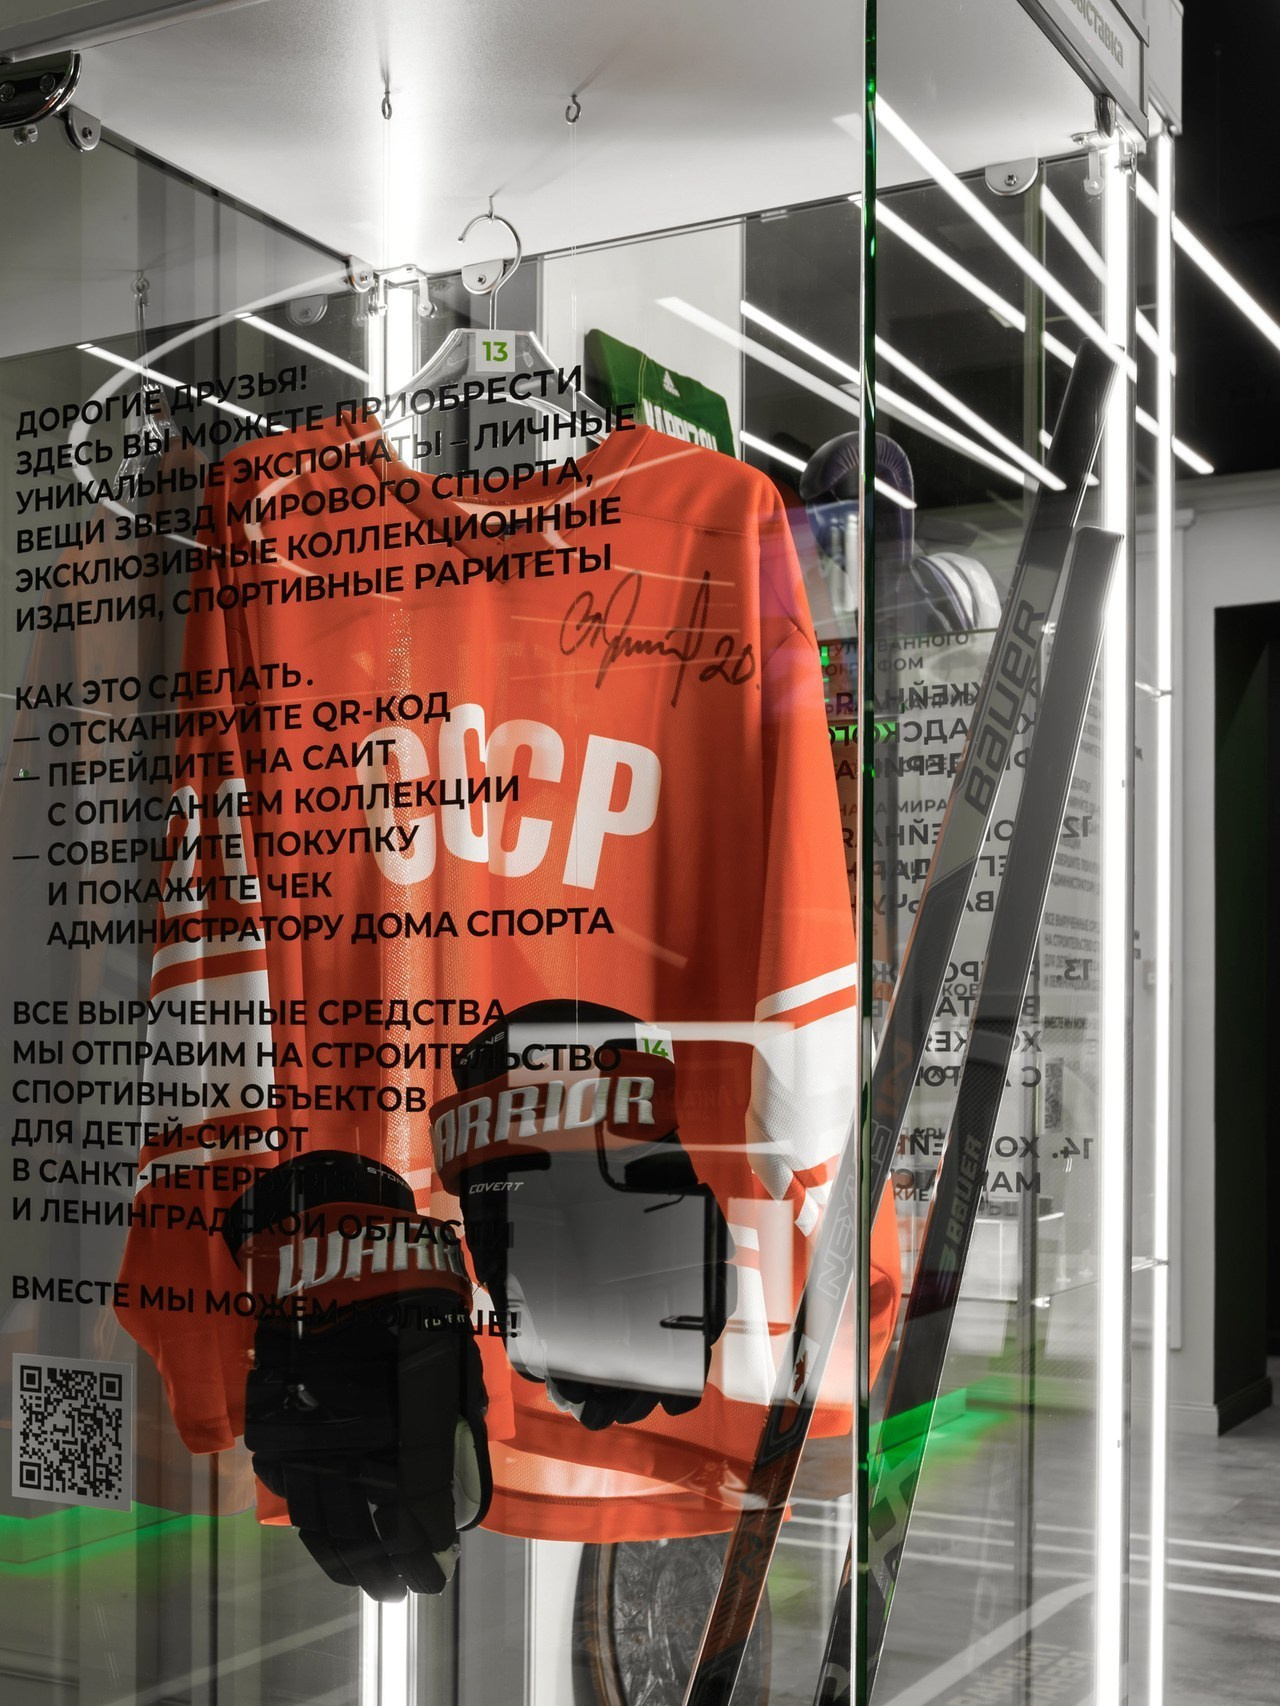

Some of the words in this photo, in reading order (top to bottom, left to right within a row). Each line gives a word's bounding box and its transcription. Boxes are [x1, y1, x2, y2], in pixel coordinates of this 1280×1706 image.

[482, 341, 508, 361] 13
[16, 388, 161, 438] ДОРОГИЕ
[171, 364, 308, 412] ДРУЗЬЯ!
[16, 440, 113, 477] ЗДЕСЬ
[124, 432, 171, 463] ВЫ
[181, 405, 323, 453] МОЖЕТЕ
[335, 364, 583, 428] ПРИОБРЕСТИ
[16, 463, 225, 515] УНИКАЛЬНЫЕ
[232, 428, 442, 485] ЭКСПОНАТЫ
[474, 402, 637, 453] ЛИЧНЫЕ
[17, 518, 106, 555] ВЕЩИ
[114, 503, 217, 543] ЗВЕЗД
[226, 475, 421, 528] МИРОВОГО
[431, 456, 595, 502] СПОРТА,
[16, 535, 278, 595] ЭКСКЛЮЗИВНЫЕ
[287, 495, 622, 562] КОЛЛЕКЦИОННЫЕ
[16, 593, 164, 634] ИЗДЕЛИЯ,
[173, 563, 405, 617] СПОРТИВНЫЕ
[415, 542, 613, 591] РАРИТЕТЫ
[16, 682, 74, 711] КАК
[82, 677, 142, 704] ЭТО
[149, 663, 315, 700] СДЕЛАТЬ.
[48, 701, 303, 749] ОТСКАНИРУЙТЕ
[312, 691, 452, 731] QR-КОД
[48, 747, 235, 790] ПЕРЕЙДИТЕ
[246, 746, 293, 775] НА
[47, 798, 68, 827] С
[74, 787, 283, 826] ОПИСАНИЕМ
[295, 774, 520, 816] КОЛЛЕКЦИИ
[356, 703, 663, 891] СССР
[47, 837, 242, 866] СОВЕРШИТЕ
[253, 824, 420, 858] ПОКУПКУ
[48, 882, 68, 907] И
[78, 875, 258, 906] ПОКАЖИТЕ
[267, 871, 333, 899] ЧЕК
[47, 912, 344, 947] АДМИНИСТРАТОРУ
[351, 908, 457, 943] ДОМА
[466, 907, 615, 938] СПОРТА
[13, 1000, 70, 1026] ВСЕ
[79, 1000, 307, 1026] ВЫРУЧЕННЫЕ
[317, 999, 507, 1031] СРЕДСТВА
[12, 1041, 63, 1066] МЫ
[71, 1039, 248, 1068] ОТПРАВИМ
[257, 1041, 303, 1069] НА
[641, 1037, 669, 1058] 14
[12, 1080, 231, 1109] СПОРТИВНЫХ
[240, 1083, 427, 1113] ОБЪЕКТОВ
[12, 1119, 73, 1149] ДЛЯ
[81, 1116, 309, 1153] ДЕТЕЙ-СИРОТ
[430, 1076, 656, 1171] ARRIOR
[13, 1159, 31, 1184] В
[469, 1181, 524, 1195] COVERT
[12, 1197, 31, 1222] И
[12, 1276, 131, 1309] ВМЕСТЕ
[140, 1286, 195, 1313] МЫ
[203, 1292, 337, 1325] МОЖЕМ
